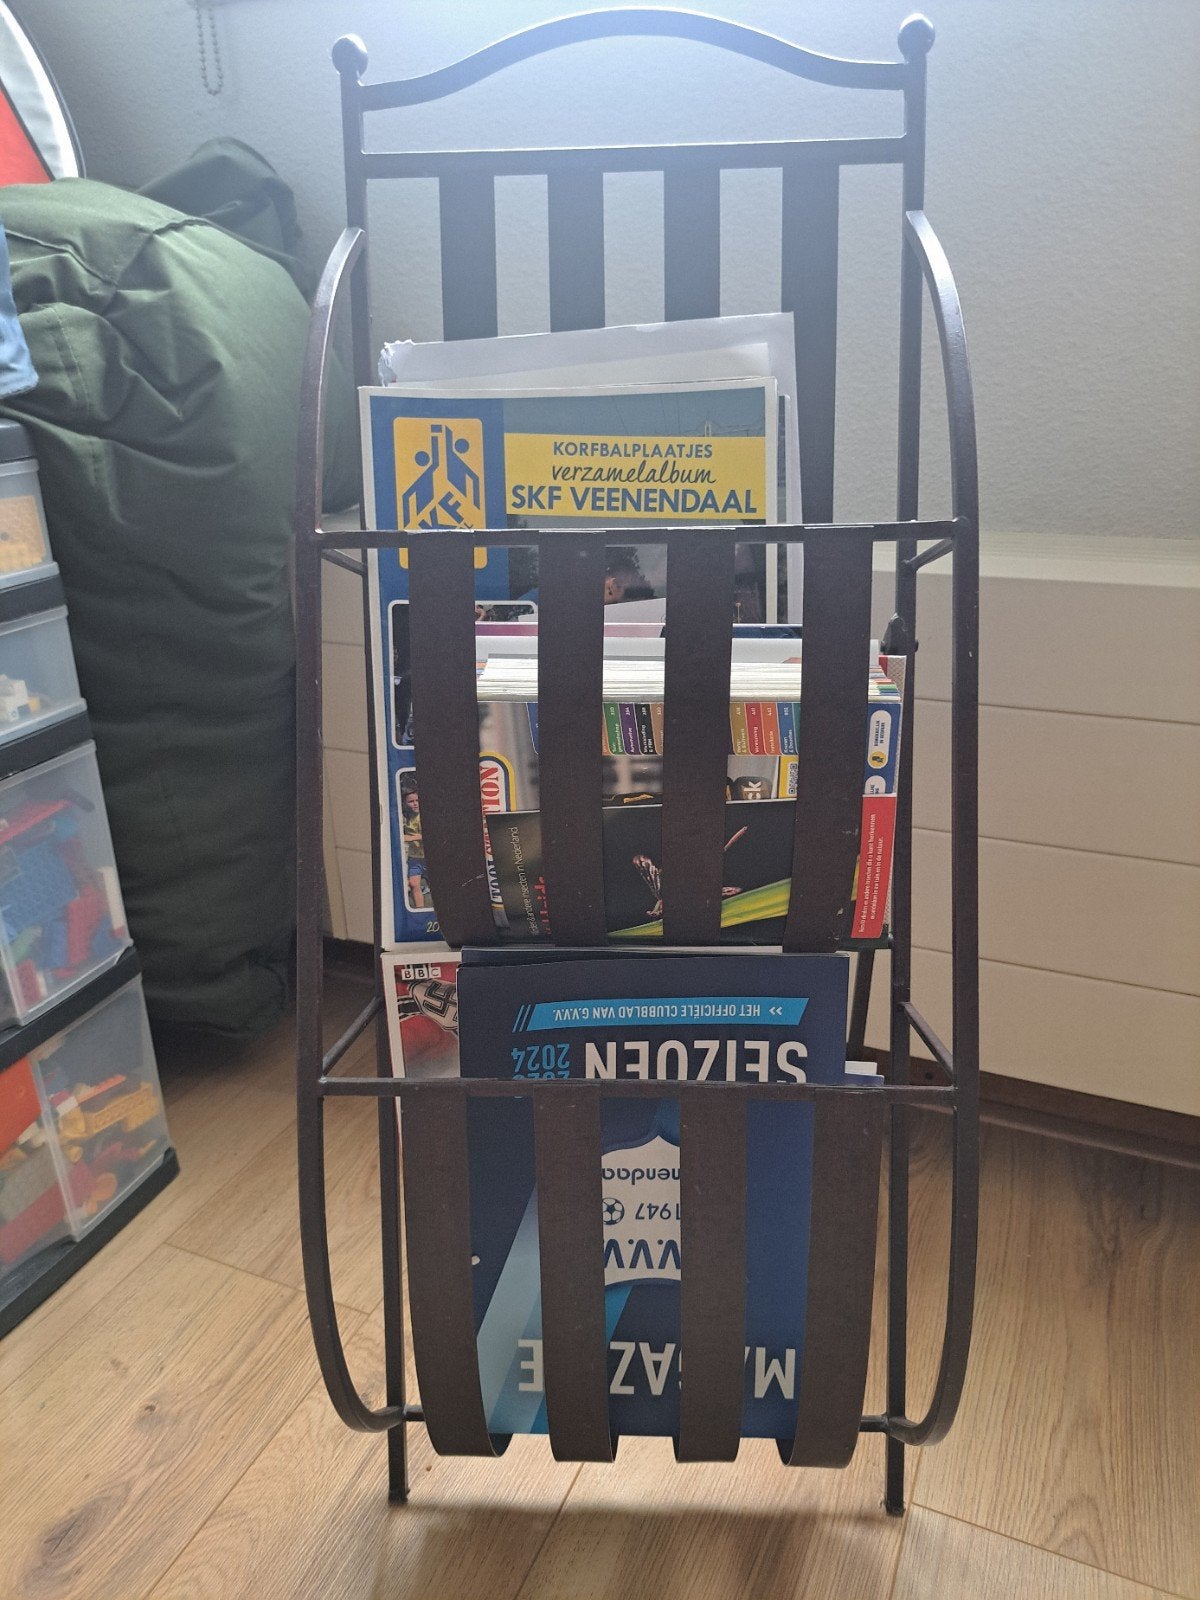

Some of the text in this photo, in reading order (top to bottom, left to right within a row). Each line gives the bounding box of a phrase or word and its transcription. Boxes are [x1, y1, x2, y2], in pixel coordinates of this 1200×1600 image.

[553, 441, 713, 459] KORFBALPLAATJES
[551, 460, 716, 484] verzamelalbum
[511, 485, 757, 514] SKF VEENENDAAL
[508, 827, 523, 864] Nederland
[426, 921, 440, 933] 20
[403, 967, 440, 979] BBC
[552, 1004, 760, 1022] HET OFFICIËLE CLUBBLAD VAN G.V.V.V.
[511, 1043, 570, 1070] 2024
[585, 1040, 808, 1082] SEIZOEN
[602, 1168, 680, 1185] nendaa
[635, 1203, 680, 1220] 1947
[604, 1239, 681, 1269] V.V.V
